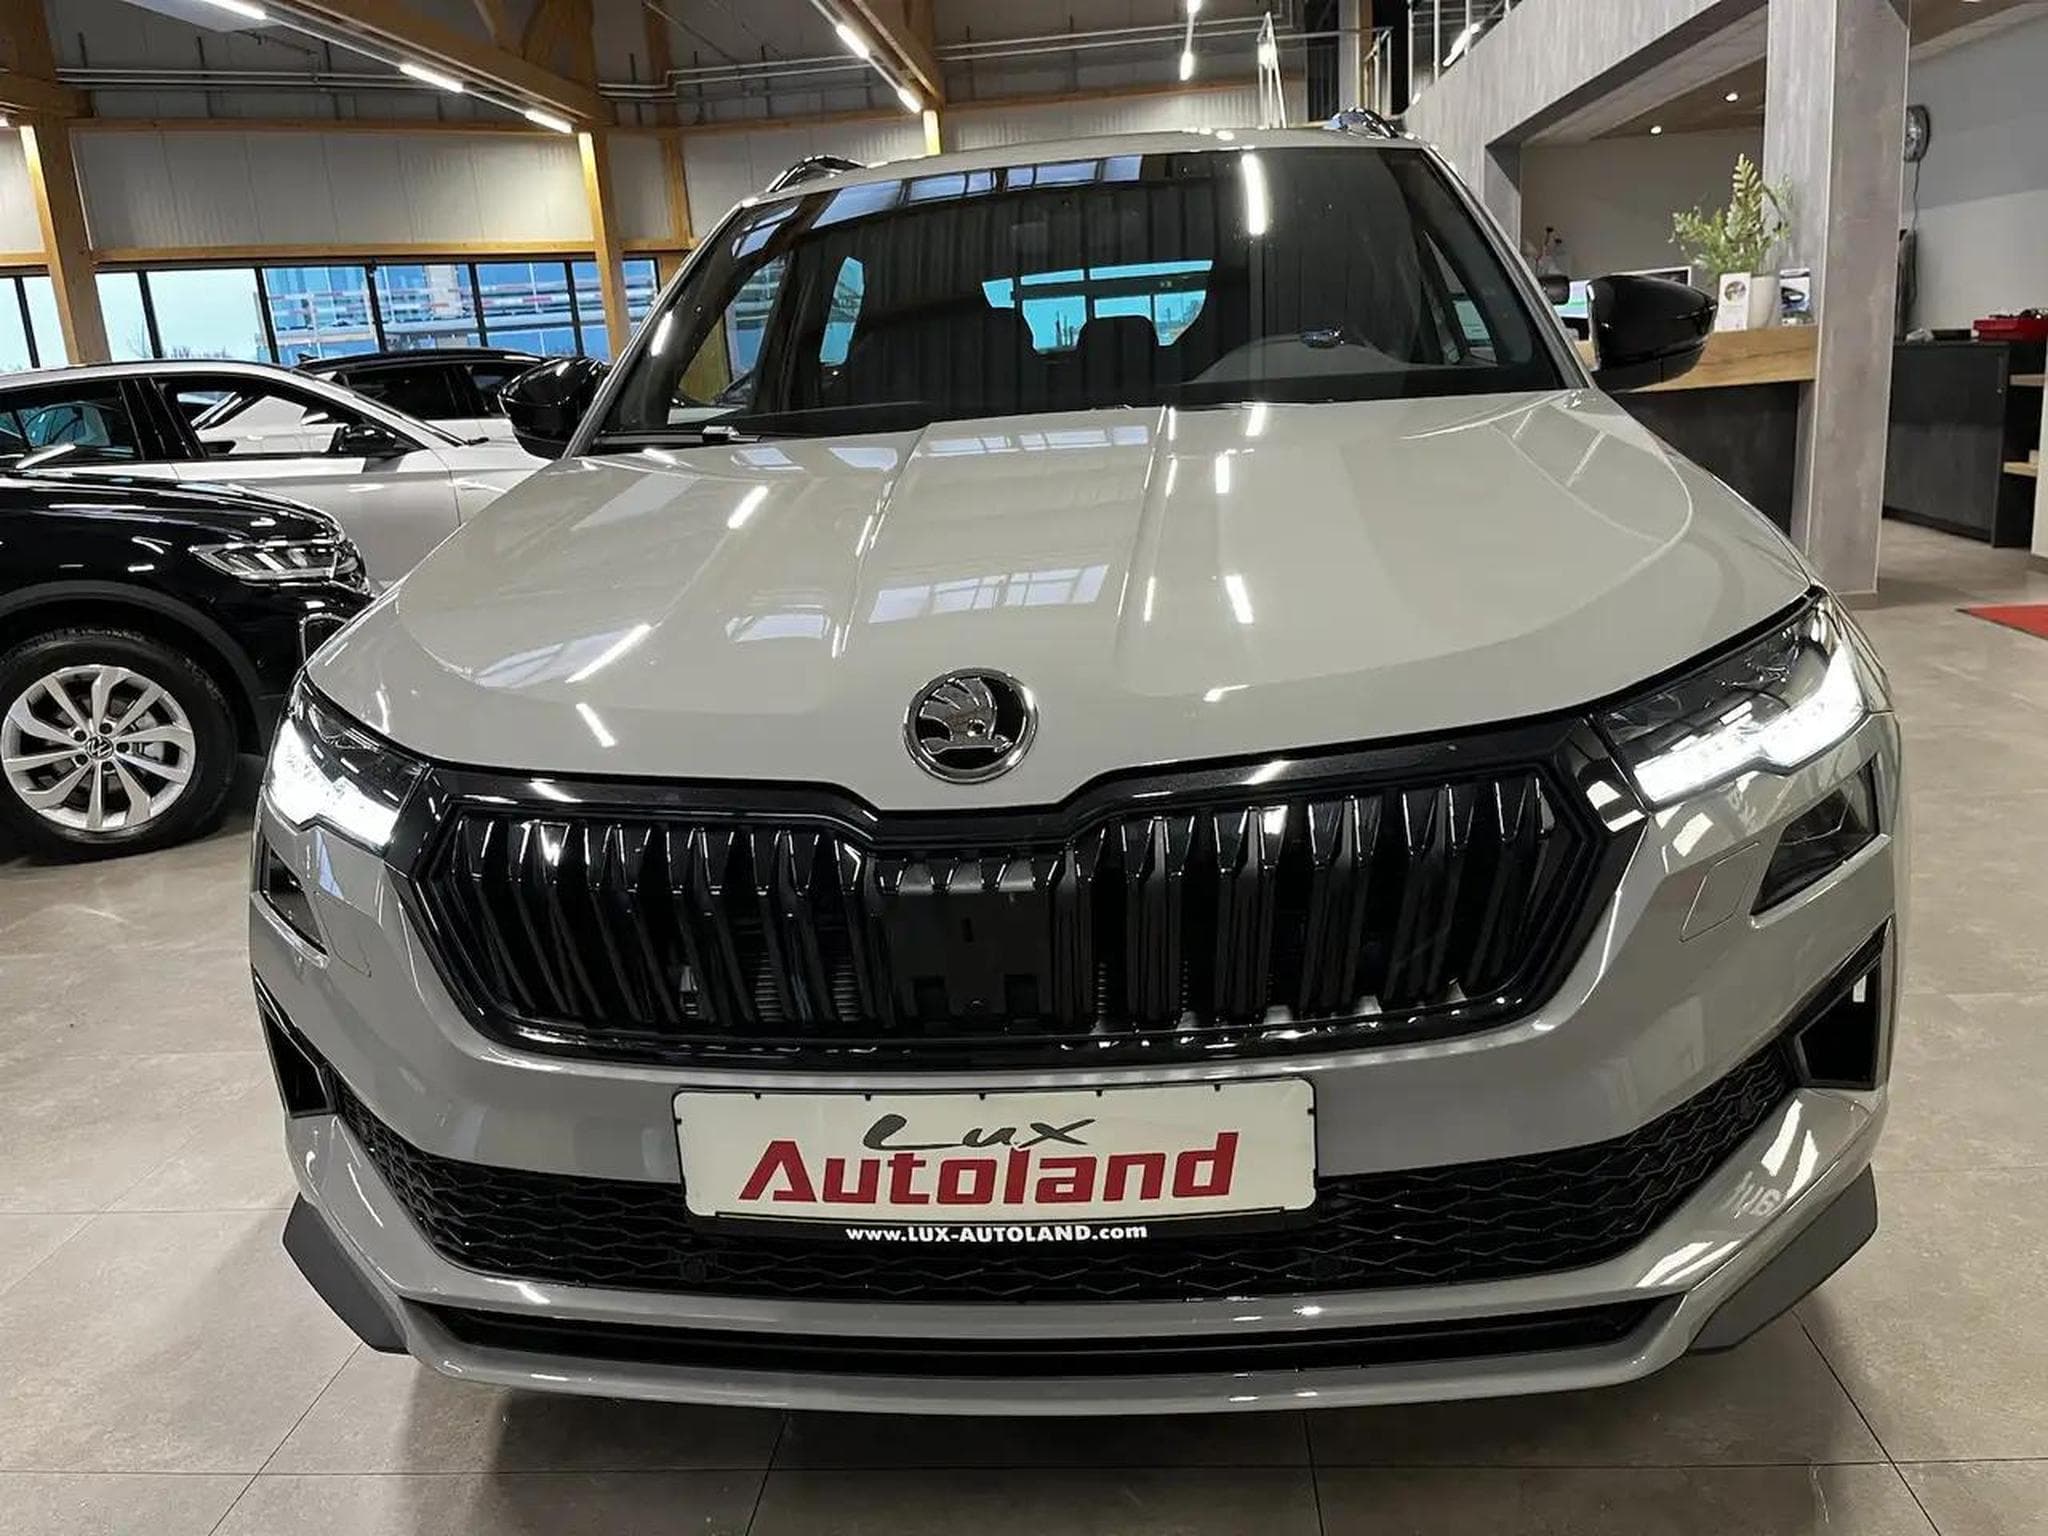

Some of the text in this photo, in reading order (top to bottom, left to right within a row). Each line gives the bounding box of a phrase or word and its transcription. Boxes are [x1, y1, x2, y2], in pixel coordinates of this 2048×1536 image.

[863, 1113, 1095, 1150] Lux
[739, 1132, 1239, 1205] Autoland
[845, 1222, 1148, 1243] www.LUX-AUTOLAND.com
